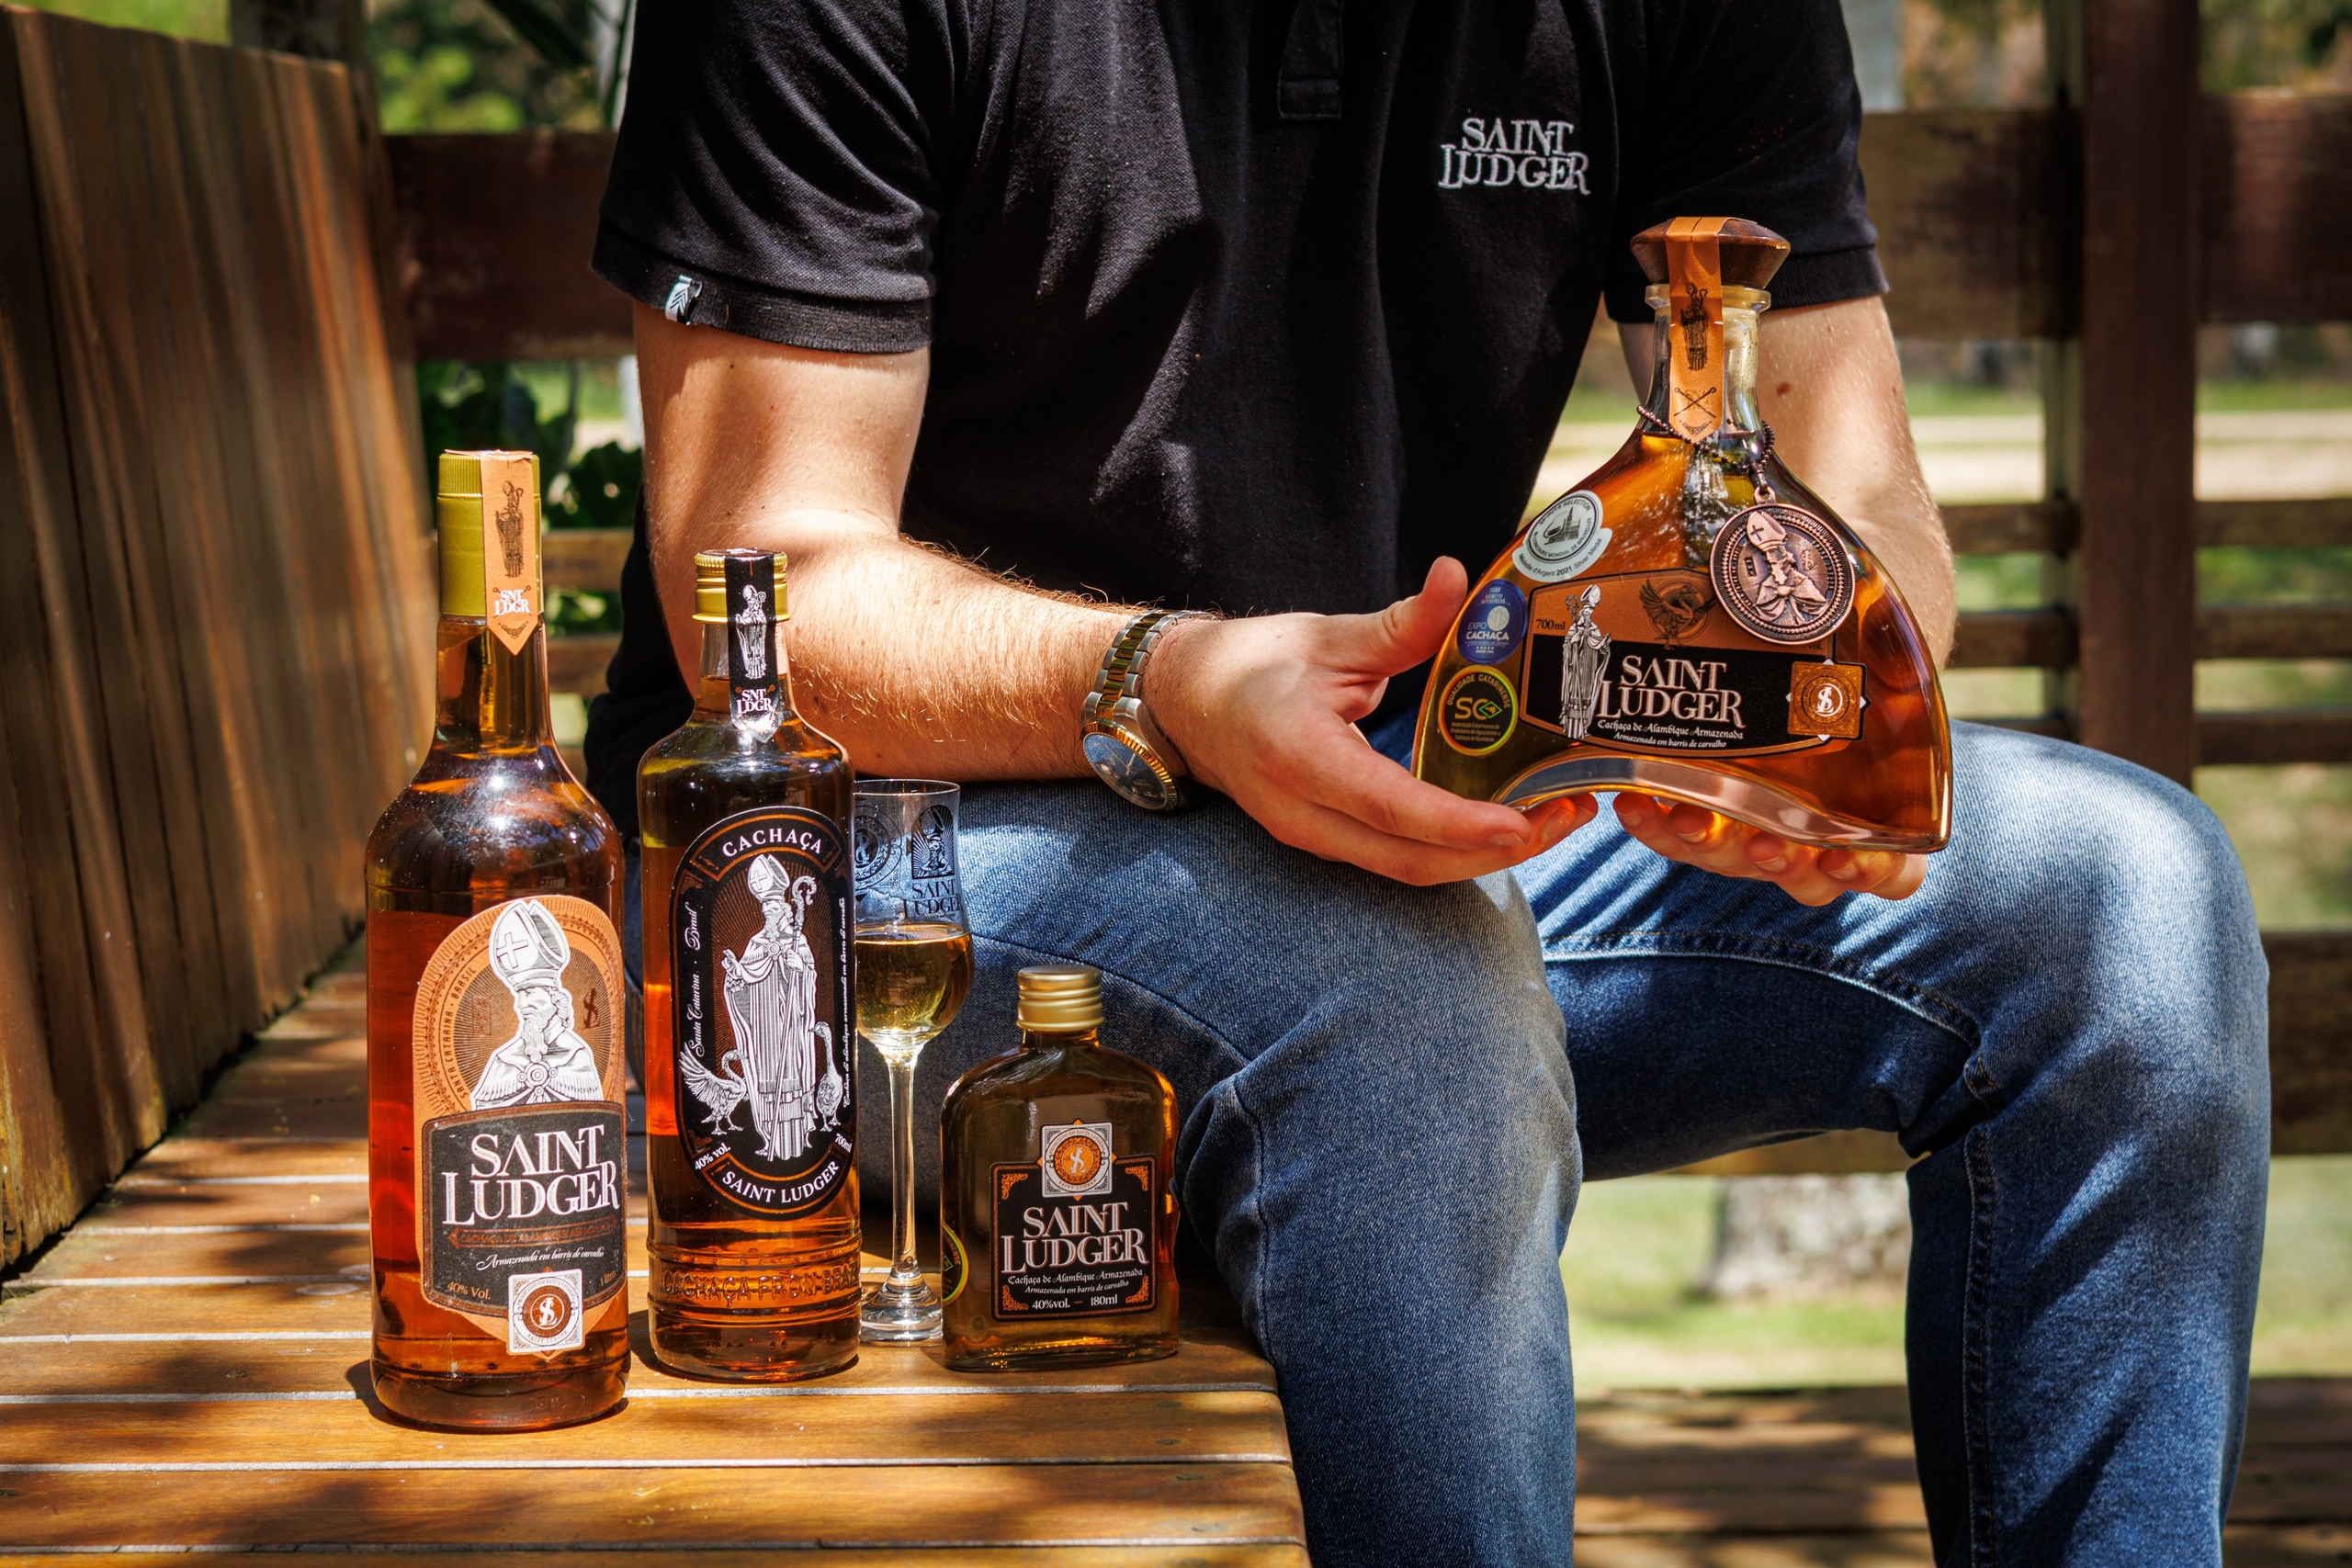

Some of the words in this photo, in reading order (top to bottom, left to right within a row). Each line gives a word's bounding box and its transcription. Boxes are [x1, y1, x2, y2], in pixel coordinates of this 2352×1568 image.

[1462, 117, 1575, 156] SAINT
[1438, 143, 1591, 195] LUDGER
[1563, 499, 1592, 512] SELECTION
[1532, 567, 1555, 578] d'Argent
[1556, 566, 1573, 576] 2021
[1574, 555, 1589, 570] Silver
[1588, 537, 1602, 556] Medal
[1465, 630, 1510, 641] CACHAÇA
[1467, 622, 1487, 630] EXPO
[1620, 654, 1727, 692] SAINT
[741, 689, 767, 702] SNT
[1446, 674, 1476, 705] QUALIDADE
[1478, 673, 1511, 708] CATARINENSE
[1595, 681, 1747, 728] LUDGER
[736, 697, 774, 715] LDGR
[1597, 718, 1631, 732] Cachaça
[1633, 722, 1643, 732] de
[1643, 723, 1690, 736] Alambique
[1690, 727, 1744, 739] Armazenada
[1613, 732, 1657, 745] Armazenada
[1668, 738, 1688, 747] barris
[1689, 739, 1697, 748] de
[722, 828, 822, 857] CACHAÇA
[911, 878, 956, 899] SAINT
[902, 893, 964, 919] LUDGER
[684, 901, 700, 951] Brasil
[451, 967, 477, 999] BRASIL
[686, 973, 703, 1021] Catarina
[443, 1010, 454, 1063] CATARINA
[688, 1021, 705, 1057] Santa
[448, 1066, 469, 1102] SANTA
[470, 1123, 605, 1177] SAINT
[694, 1153, 714, 1170] 40%
[712, 1142, 731, 1158] vol.
[834, 1133, 853, 1154] 700ml
[441, 1160, 621, 1226] LUDGER
[722, 1170, 776, 1203] SAINT
[781, 1160, 840, 1203] LUDGER
[1058, 1180, 1074, 1190] SAINT
[1023, 1201, 1129, 1239] SAINT
[476, 1250, 538, 1271] Armazenada
[539, 1253, 550, 1261] em
[550, 1247, 572, 1261] barris
[571, 1247, 582, 1258] de
[581, 1247, 605, 1258] carvalho
[1001, 1227, 1149, 1275] LUDGER
[447, 1281, 469, 1294] 40%
[470, 1287, 492, 1300] Vol.
[663, 1269, 752, 1308] CACHAÇA
[757, 1271, 817, 1301] FROM
[1008, 1275, 1041, 1285] Cachaça
[1042, 1275, 1051, 1283] de
[1053, 1273, 1095, 1283] Alambique
[1096, 1269, 1143, 1280] Armazenada
[1024, 1286, 1066, 1294] Armazenada
[1077, 1285, 1094, 1293] barris
[1095, 1283, 1103, 1292] de
[1103, 1280, 1129, 1291] carvalho
[1091, 1294, 1118, 1306] 180ml
